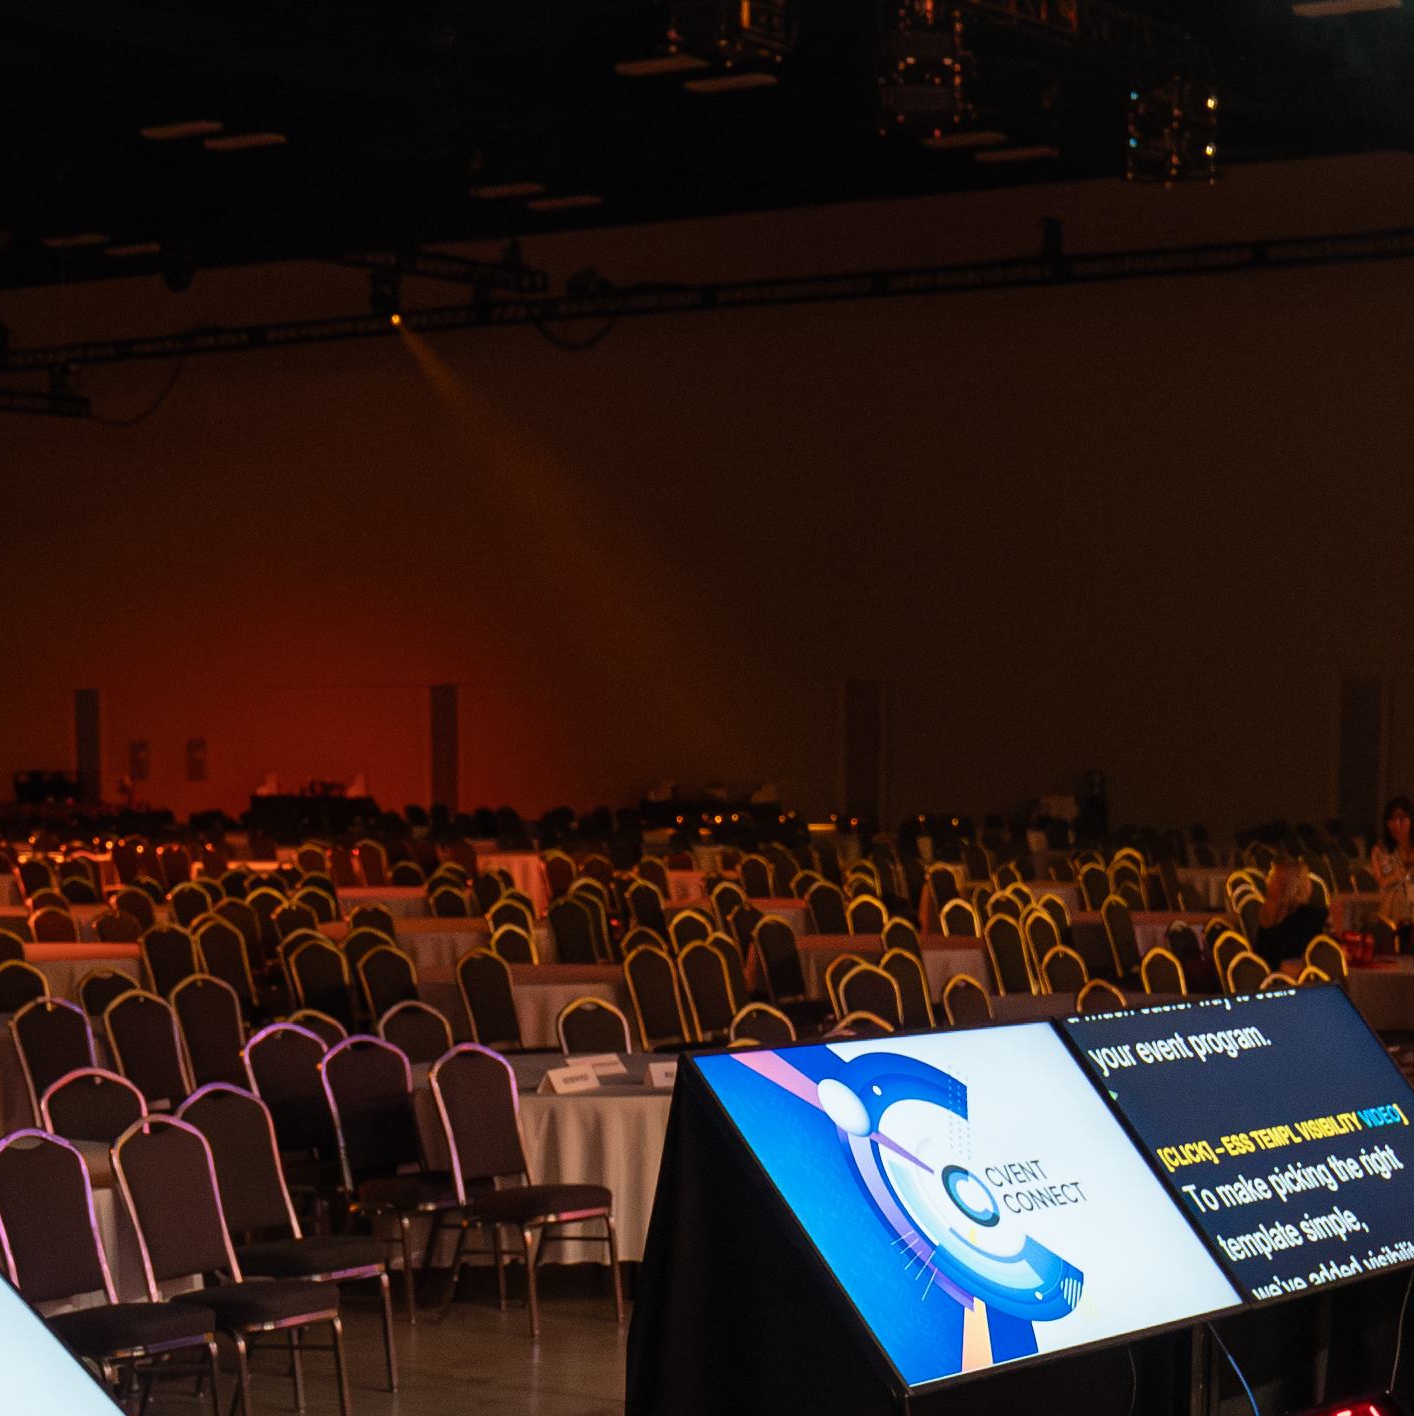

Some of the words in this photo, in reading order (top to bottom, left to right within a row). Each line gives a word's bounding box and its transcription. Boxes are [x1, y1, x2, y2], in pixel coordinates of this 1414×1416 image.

[1087, 1044, 1137, 1078] your
[1135, 1031, 1194, 1064] event
[1187, 1026, 1272, 1063] program.
[1156, 1140, 1220, 1173] [CLICK]
[1220, 1132, 1256, 1157] ESS
[1248, 1124, 1303, 1150] TEMPL
[1293, 1111, 1363, 1141] VISIBILITY
[1356, 1102, 1410, 1129] VIDEO]
[984, 1159, 1048, 1188] CVENT
[1003, 1181, 1088, 1214] CONNECT
[1181, 1183, 1220, 1213] To
[1215, 1174, 1273, 1208] make
[1267, 1163, 1339, 1203] picking
[1326, 1154, 1364, 1183] the
[1358, 1143, 1405, 1180] right
[1216, 1220, 1304, 1262] template
[1299, 1205, 1370, 1242] simple,
